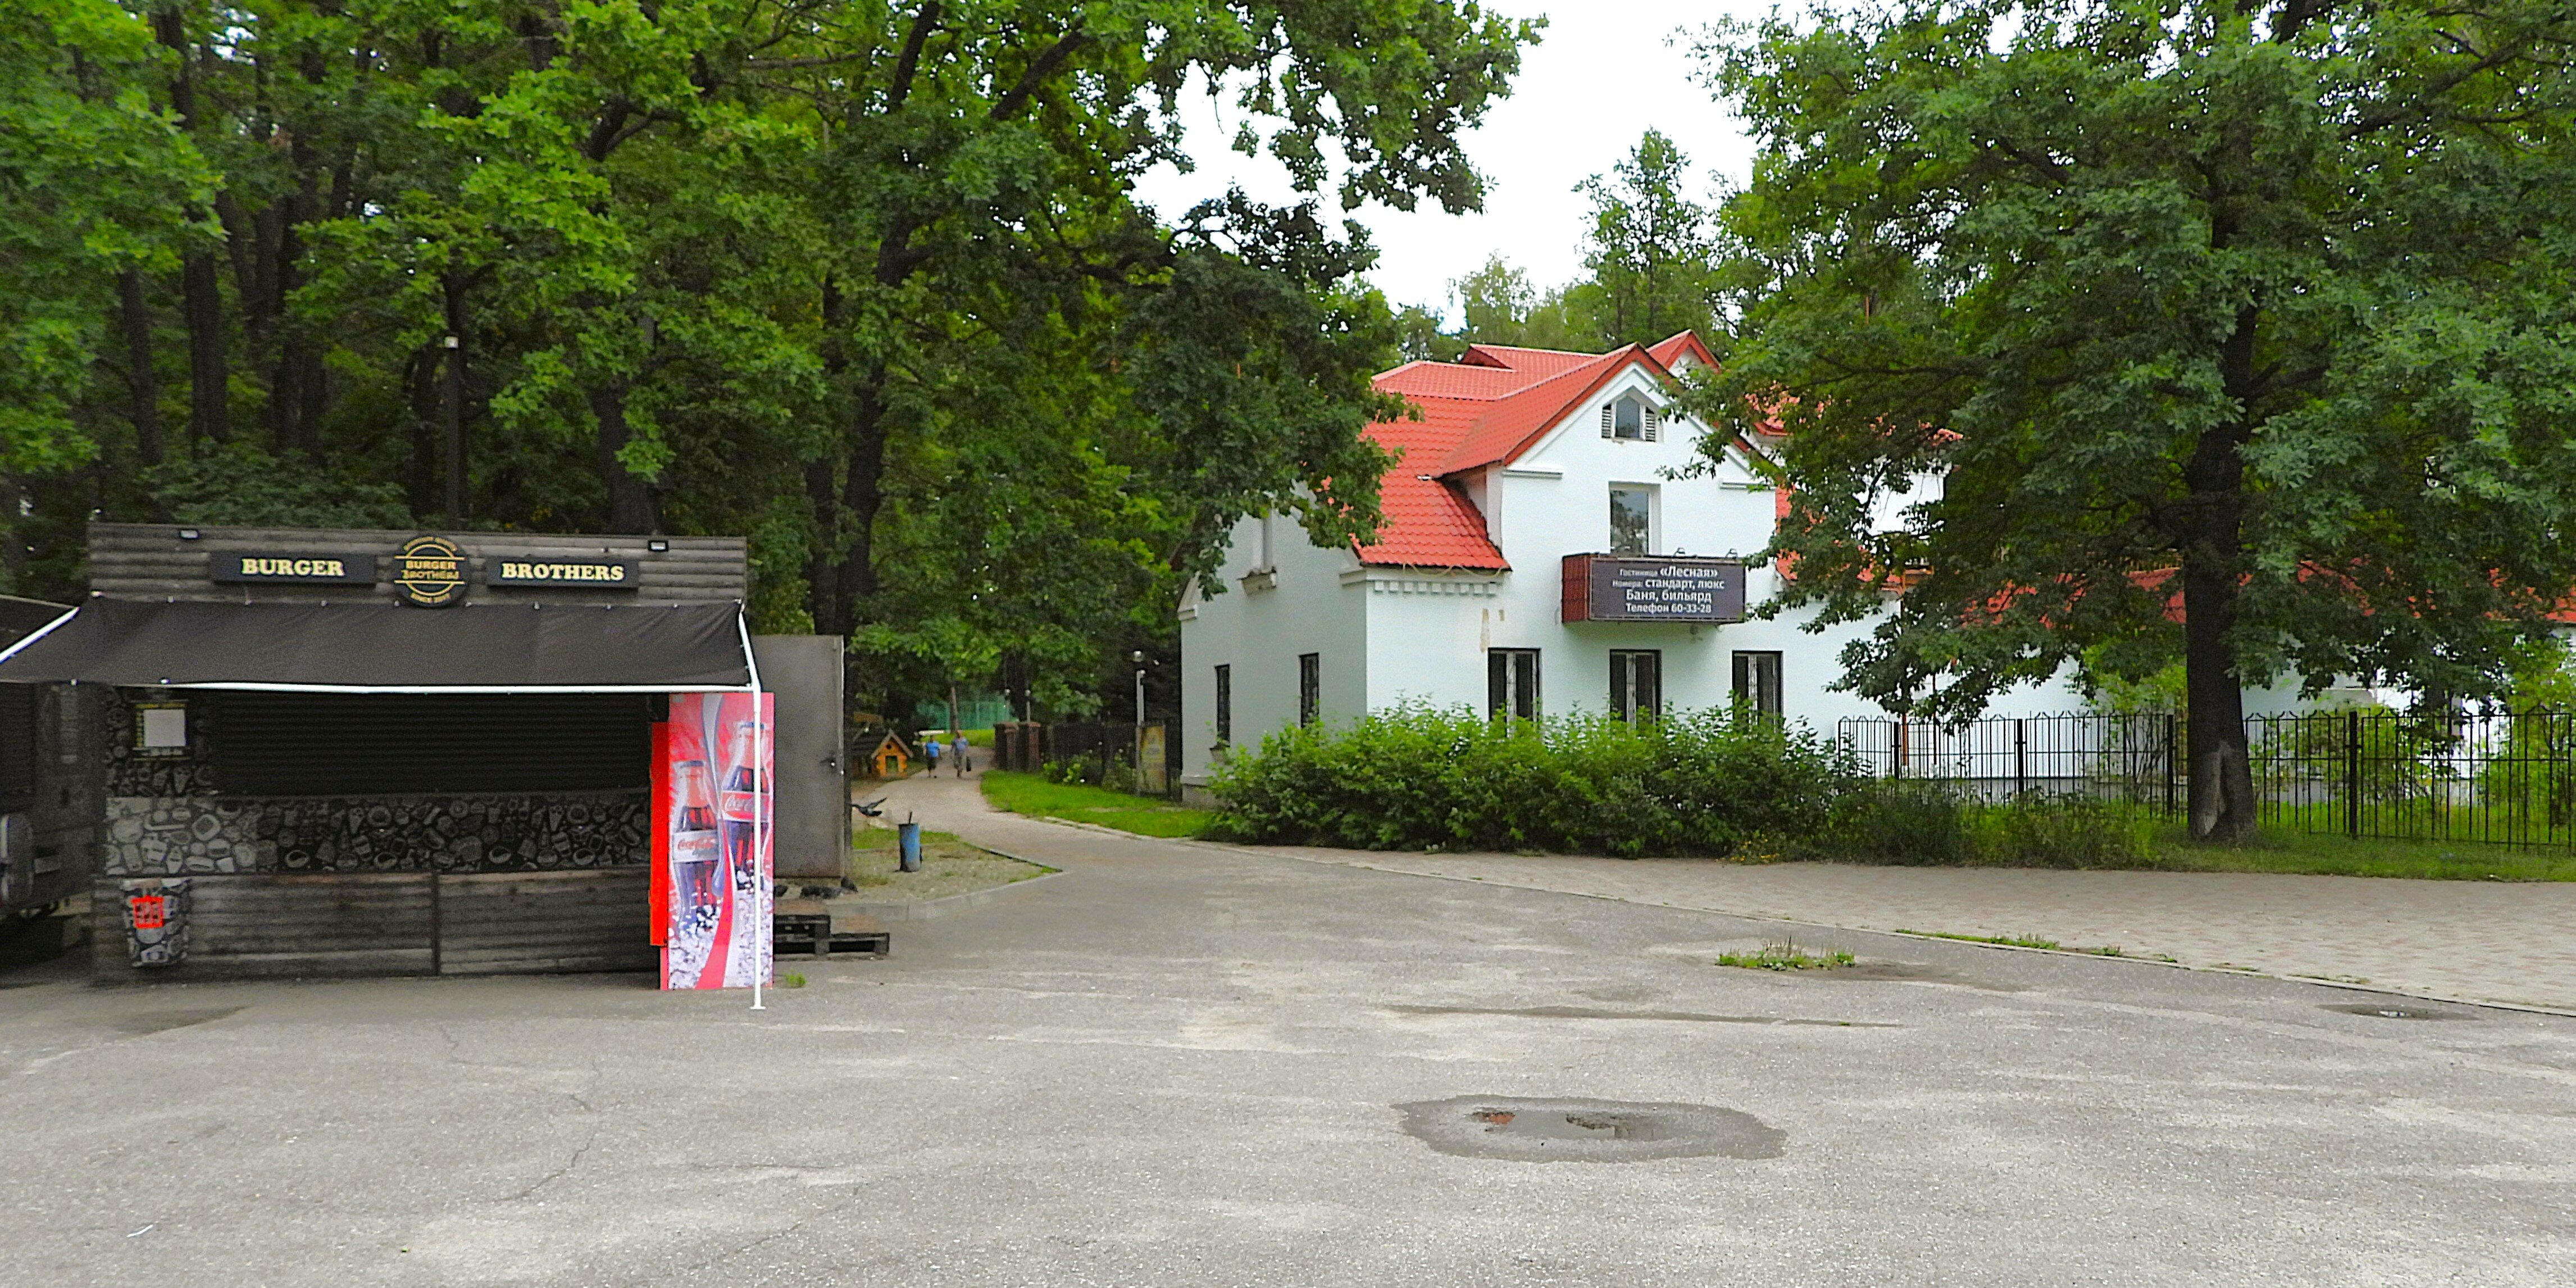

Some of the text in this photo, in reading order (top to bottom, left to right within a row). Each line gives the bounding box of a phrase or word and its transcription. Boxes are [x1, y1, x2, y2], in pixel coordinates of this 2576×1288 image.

[242, 558, 625, 581] BURGER BROTHERS
[406, 559, 457, 570] BURGER
[1660, 565, 1718, 578] «Лесная»
[1645, 579, 1695, 590] стандарт,
[1697, 580, 1726, 589] люкс
[1626, 588, 1712, 604] Баня, бильярд
[1626, 602, 1712, 614] Телефон 60-33-28
